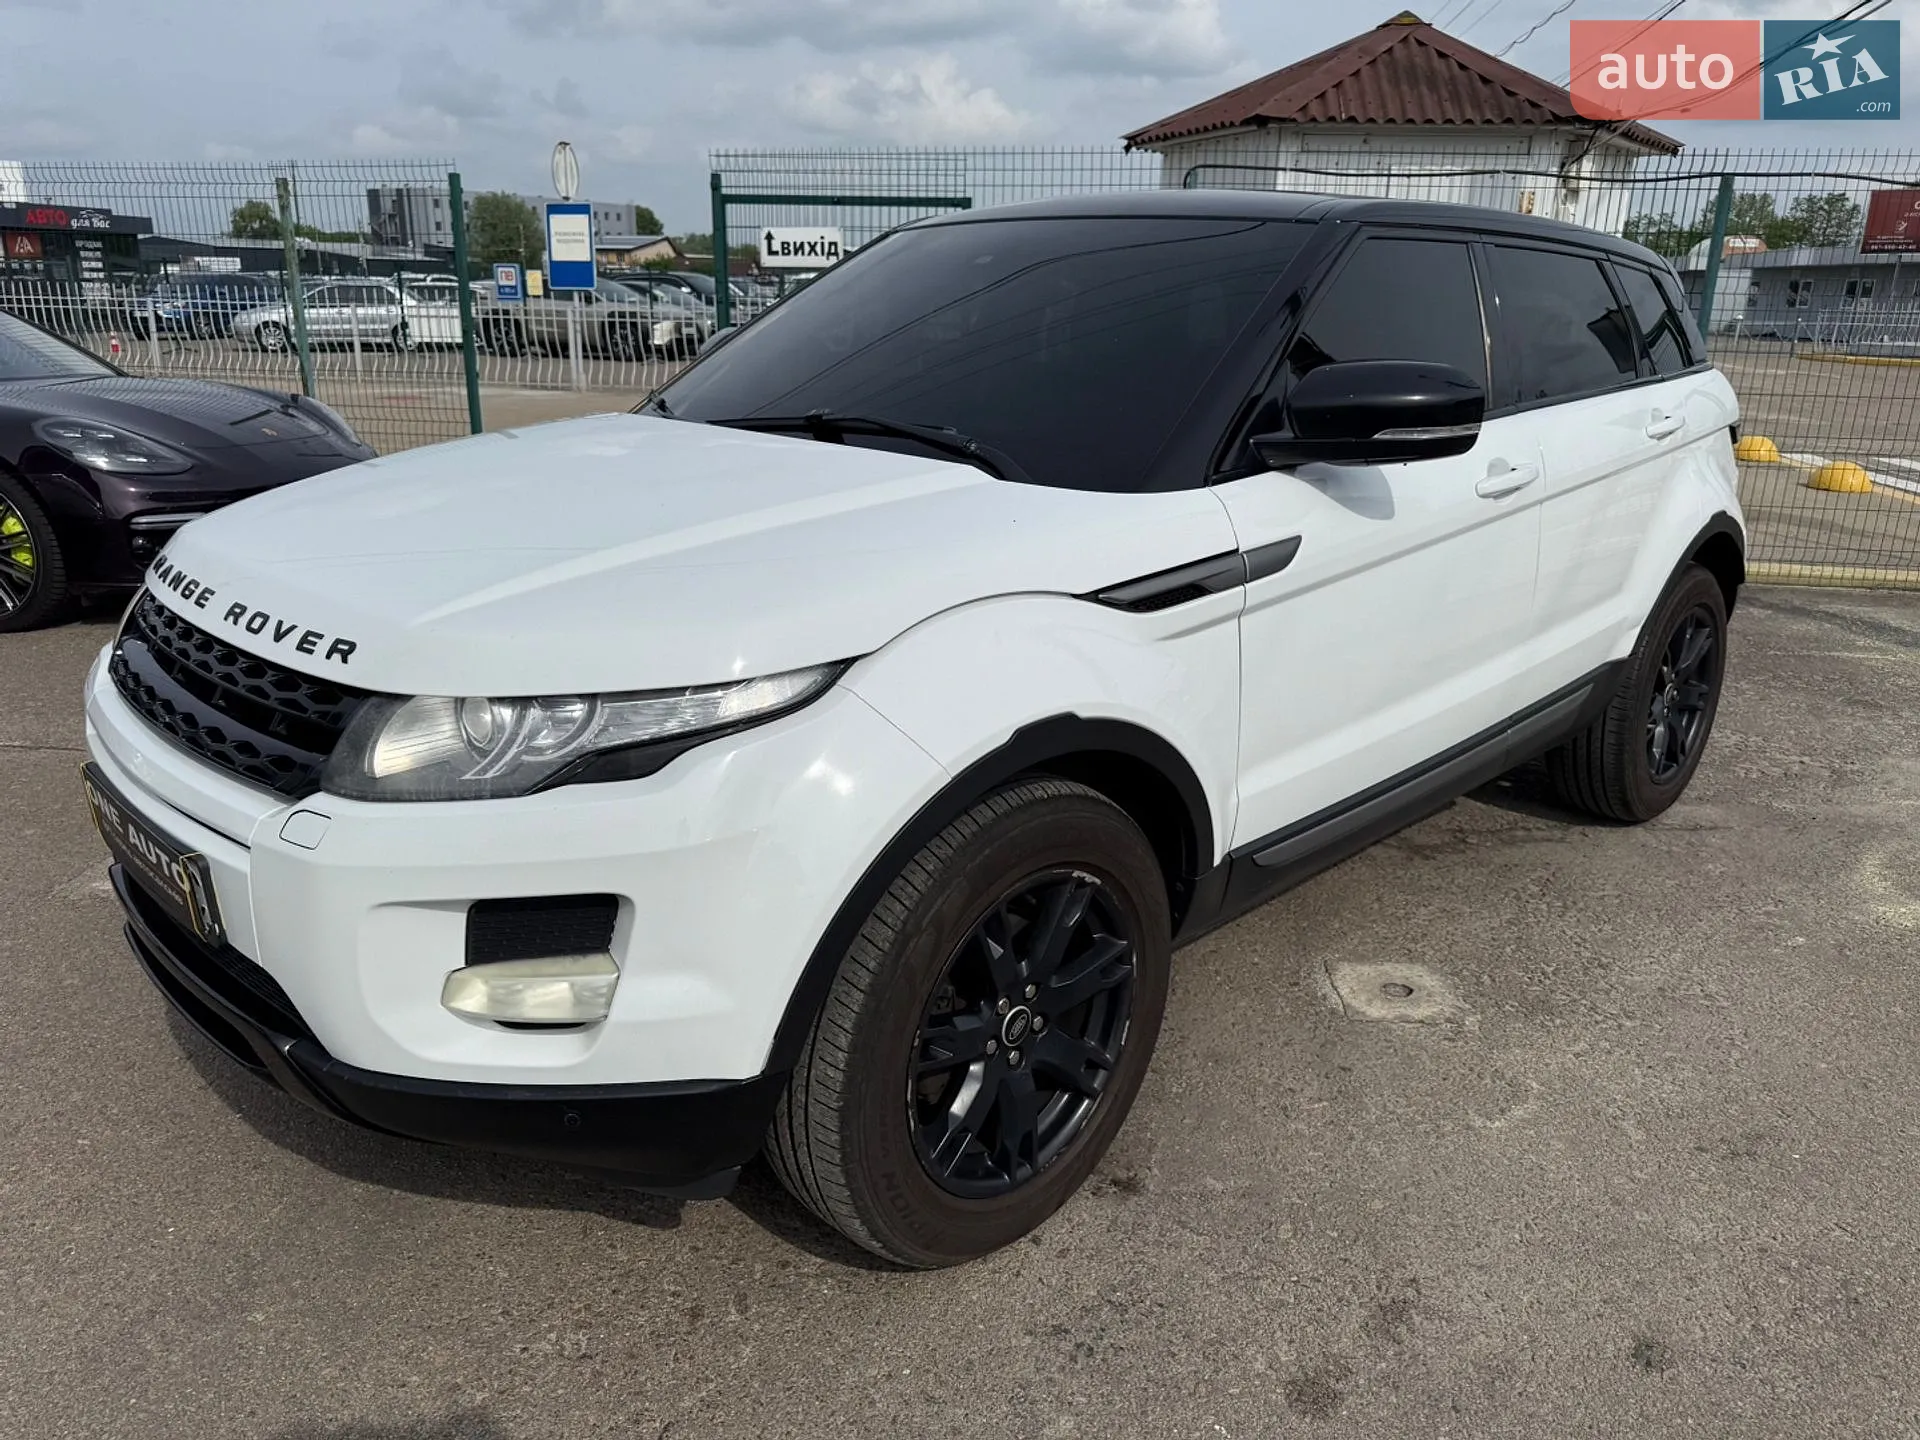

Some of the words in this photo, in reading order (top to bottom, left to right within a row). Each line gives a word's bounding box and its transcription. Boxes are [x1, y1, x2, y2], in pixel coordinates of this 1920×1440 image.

[781, 236, 839, 261] вихід
[152, 554, 216, 609] RANGE
[223, 601, 357, 664] ROVER
